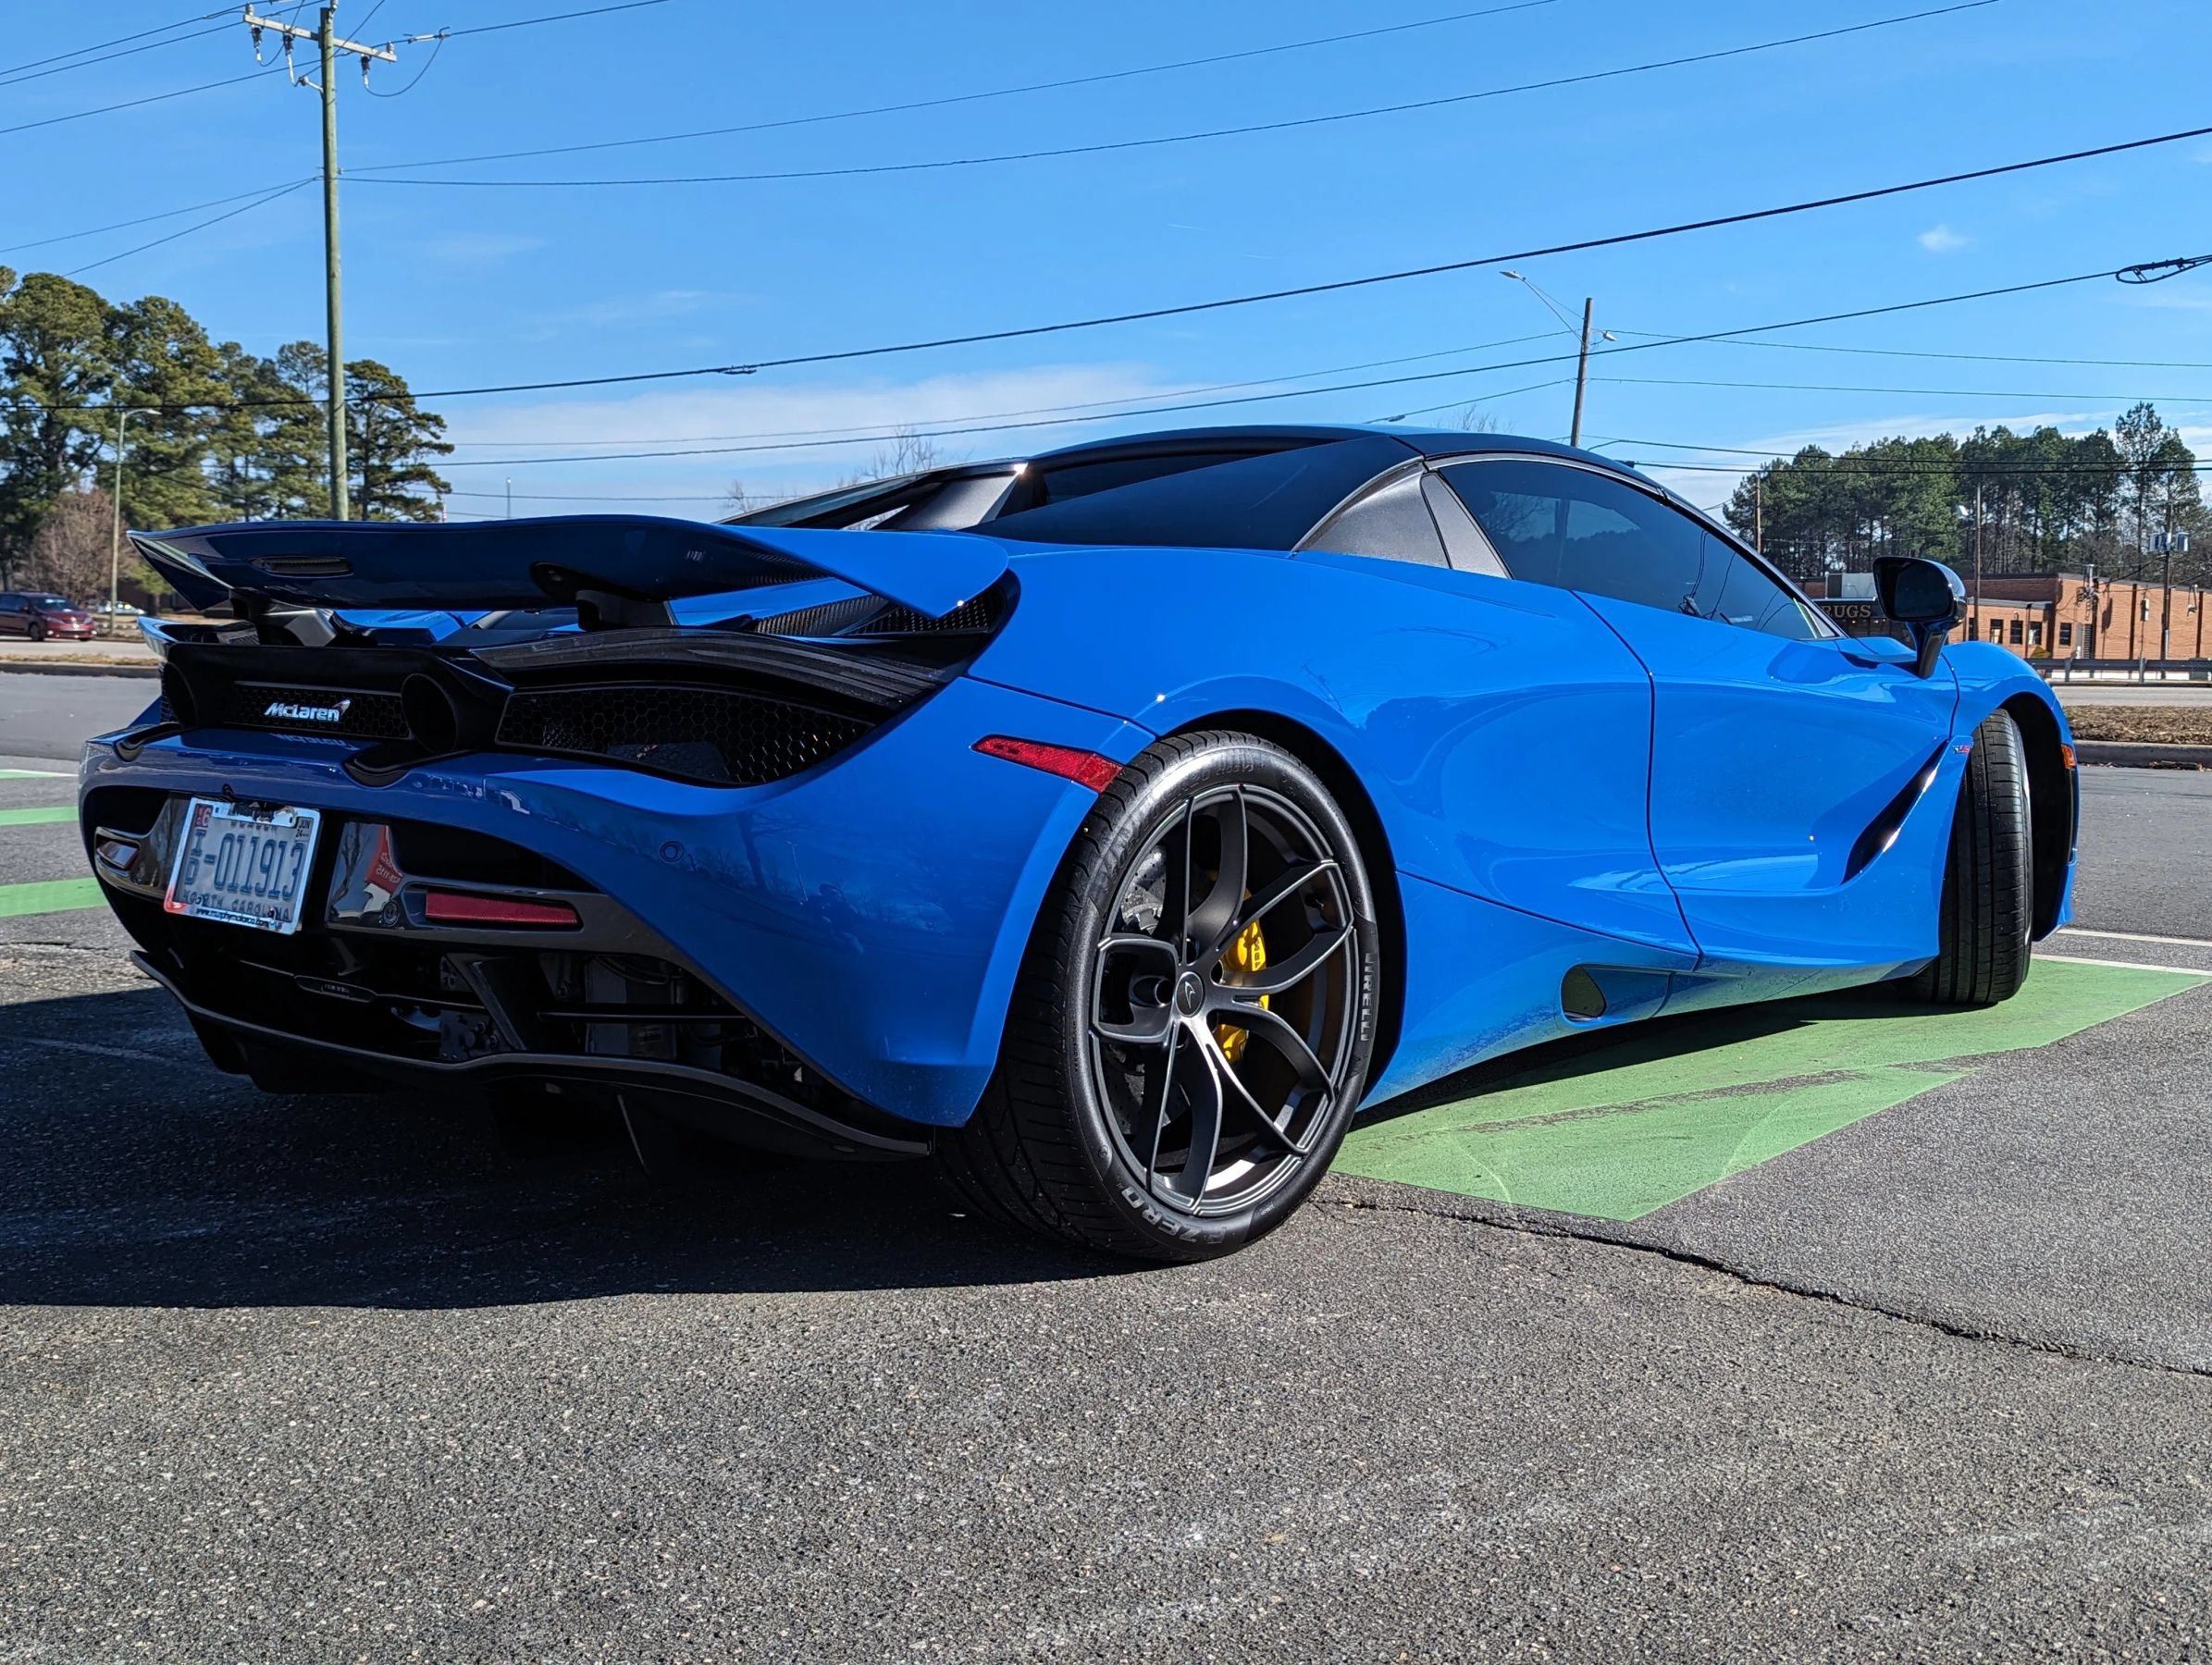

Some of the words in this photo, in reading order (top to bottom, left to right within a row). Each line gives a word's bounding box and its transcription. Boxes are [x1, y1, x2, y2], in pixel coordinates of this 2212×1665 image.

[264, 702, 340, 722] McLaren
[231, 898, 290, 920] CAROLNA
[1121, 1186, 1203, 1244] ZERO
